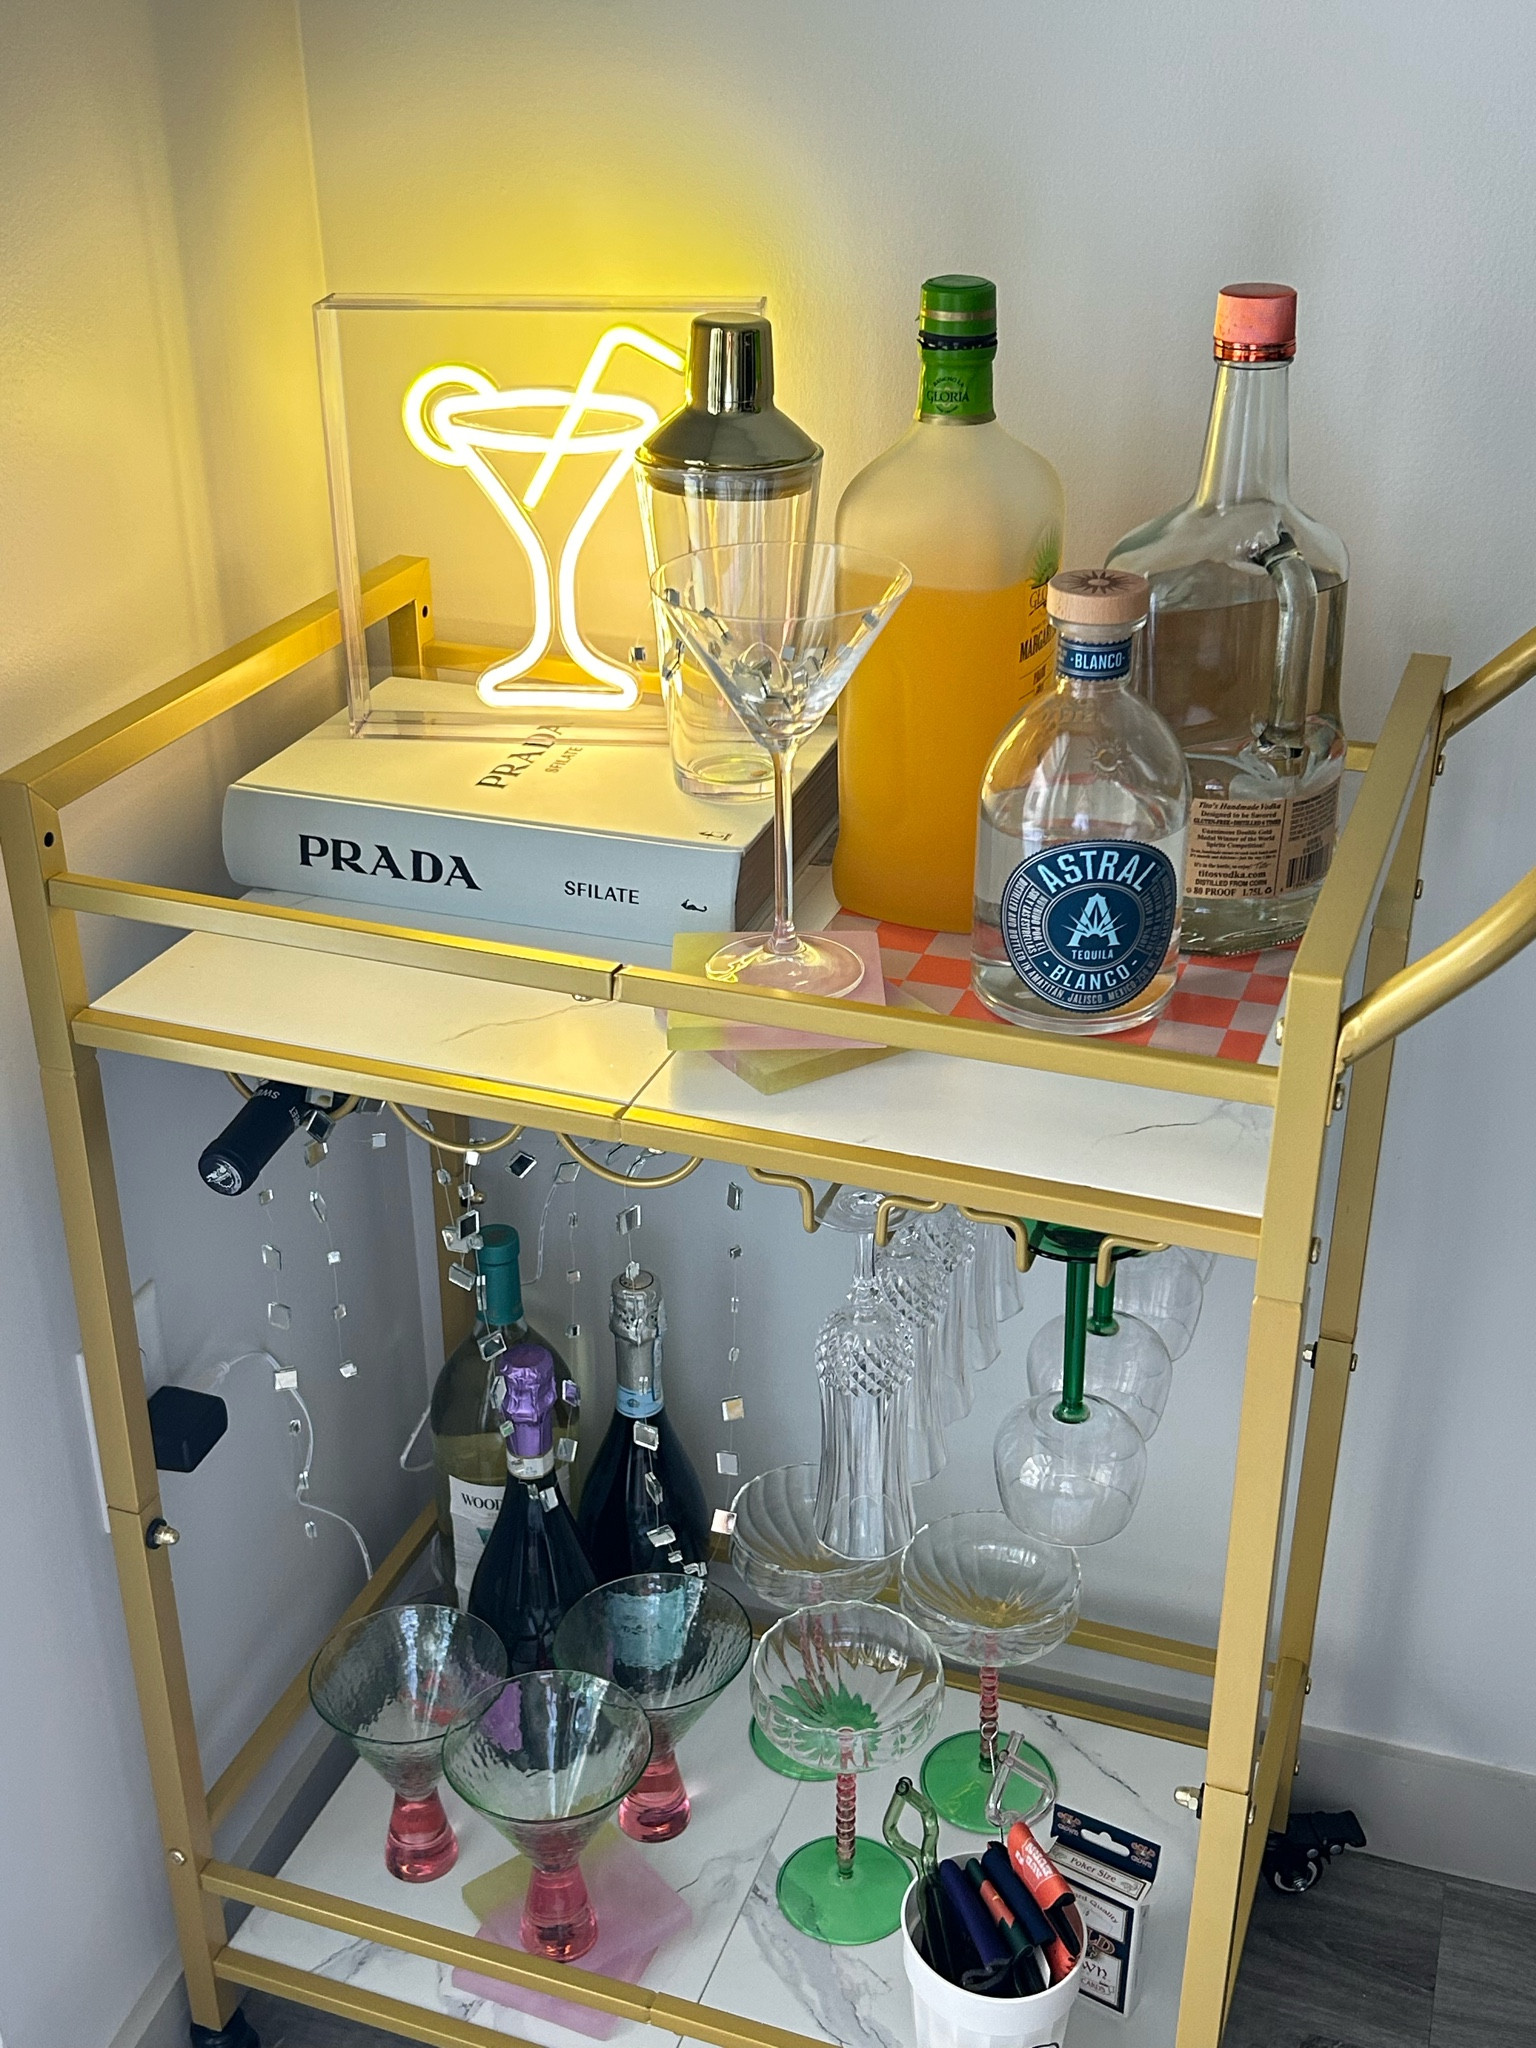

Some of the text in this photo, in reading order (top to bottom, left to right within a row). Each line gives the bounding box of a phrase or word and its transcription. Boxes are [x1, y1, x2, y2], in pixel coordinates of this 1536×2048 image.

[926, 387, 970, 404] GLORIA
[1074, 652, 1123, 670] BLANCO
[475, 722, 575, 789] PRADA
[545, 745, 584, 773] SFILATE
[1219, 803, 1259, 811] Handmade
[298, 834, 483, 891] PRADA
[1037, 850, 1156, 894] ASTRAL
[1198, 870, 1266, 879] titosvodka.com
[564, 880, 641, 905] SFILATE
[1193, 887, 1203, 895] 80
[1205, 887, 1237, 896] PROOF
[1071, 949, 1114, 961] TEQUILA
[1049, 964, 1130, 990] BLANCO
[1070, 1857, 1097, 1874] Poker
[1097, 1868, 1117, 1884] Size
[1089, 1898, 1119, 1924] Quality
